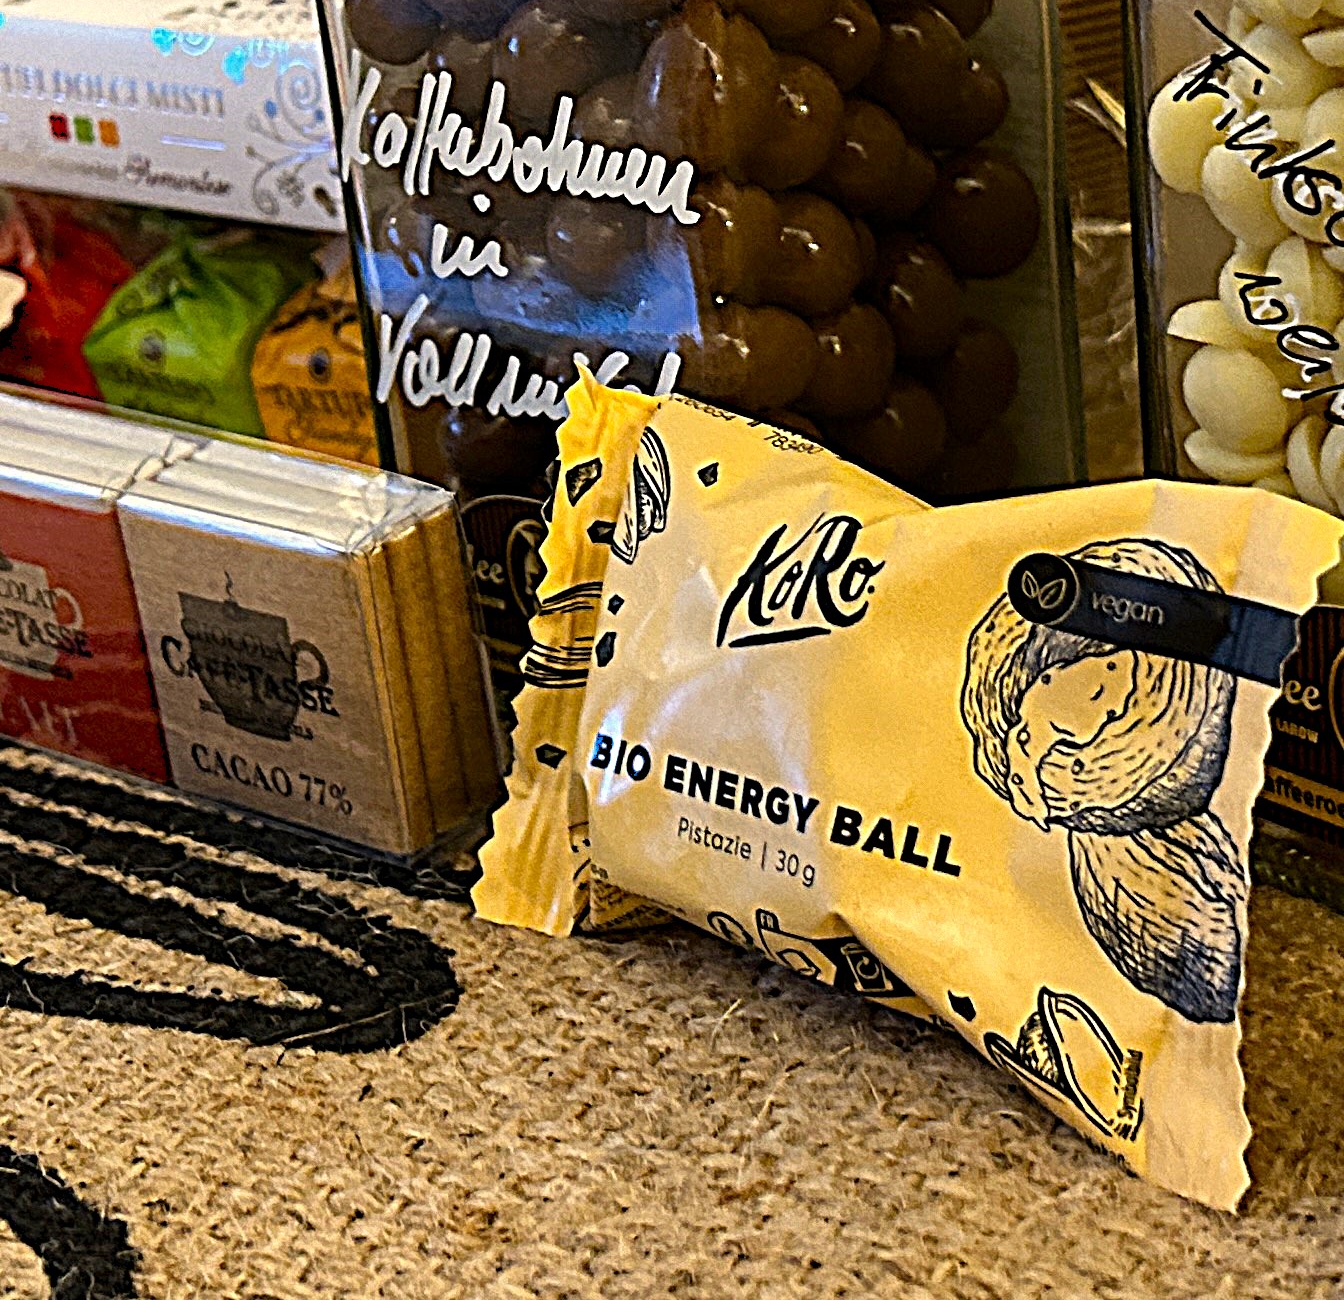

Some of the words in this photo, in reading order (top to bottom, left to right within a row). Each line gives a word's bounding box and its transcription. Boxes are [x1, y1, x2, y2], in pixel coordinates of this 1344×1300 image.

[430, 193, 510, 279] in
[1088, 590, 1167, 629] vegan
[190, 742, 294, 798] CACAO
[299, 773, 355, 817] 77%
[590, 733, 652, 784] BIO
[662, 754, 821, 834] ENERGY
[828, 804, 963, 879] BALL
[676, 816, 754, 862] Pistazie
